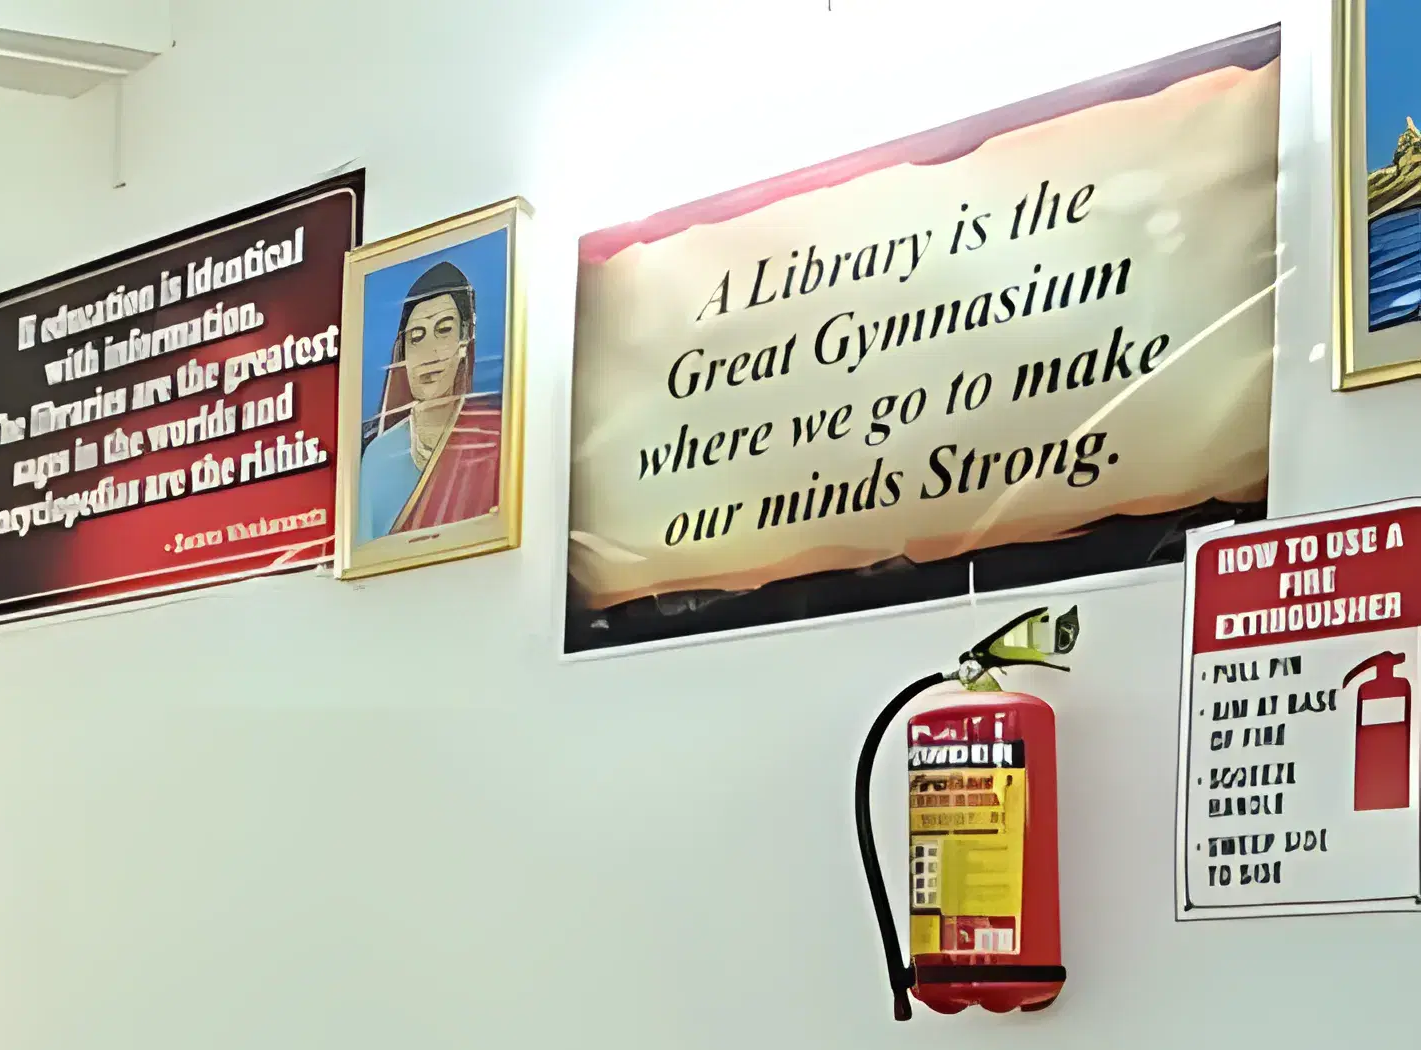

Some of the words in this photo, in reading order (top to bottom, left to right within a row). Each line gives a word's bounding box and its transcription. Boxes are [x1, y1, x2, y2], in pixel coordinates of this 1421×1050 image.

[695, 269, 731, 322] A
[744, 229, 933, 310] Library
[949, 203, 992, 255] is
[1009, 180, 1096, 241] the
[667, 332, 797, 399] Great
[814, 257, 1132, 374] Gymnasium
[638, 421, 773, 481] where
[792, 404, 853, 448] we
[864, 387, 927, 447] go
[945, 370, 993, 416] to
[1011, 325, 1170, 402] make
[664, 502, 744, 547] our
[757, 456, 904, 530] minds
[919, 432, 1120, 500] Strong.
[1217, 540, 1279, 576] HOW
[1284, 535, 1319, 565] TO
[1326, 525, 1378, 559] USE
[1385, 522, 1405, 550] A
